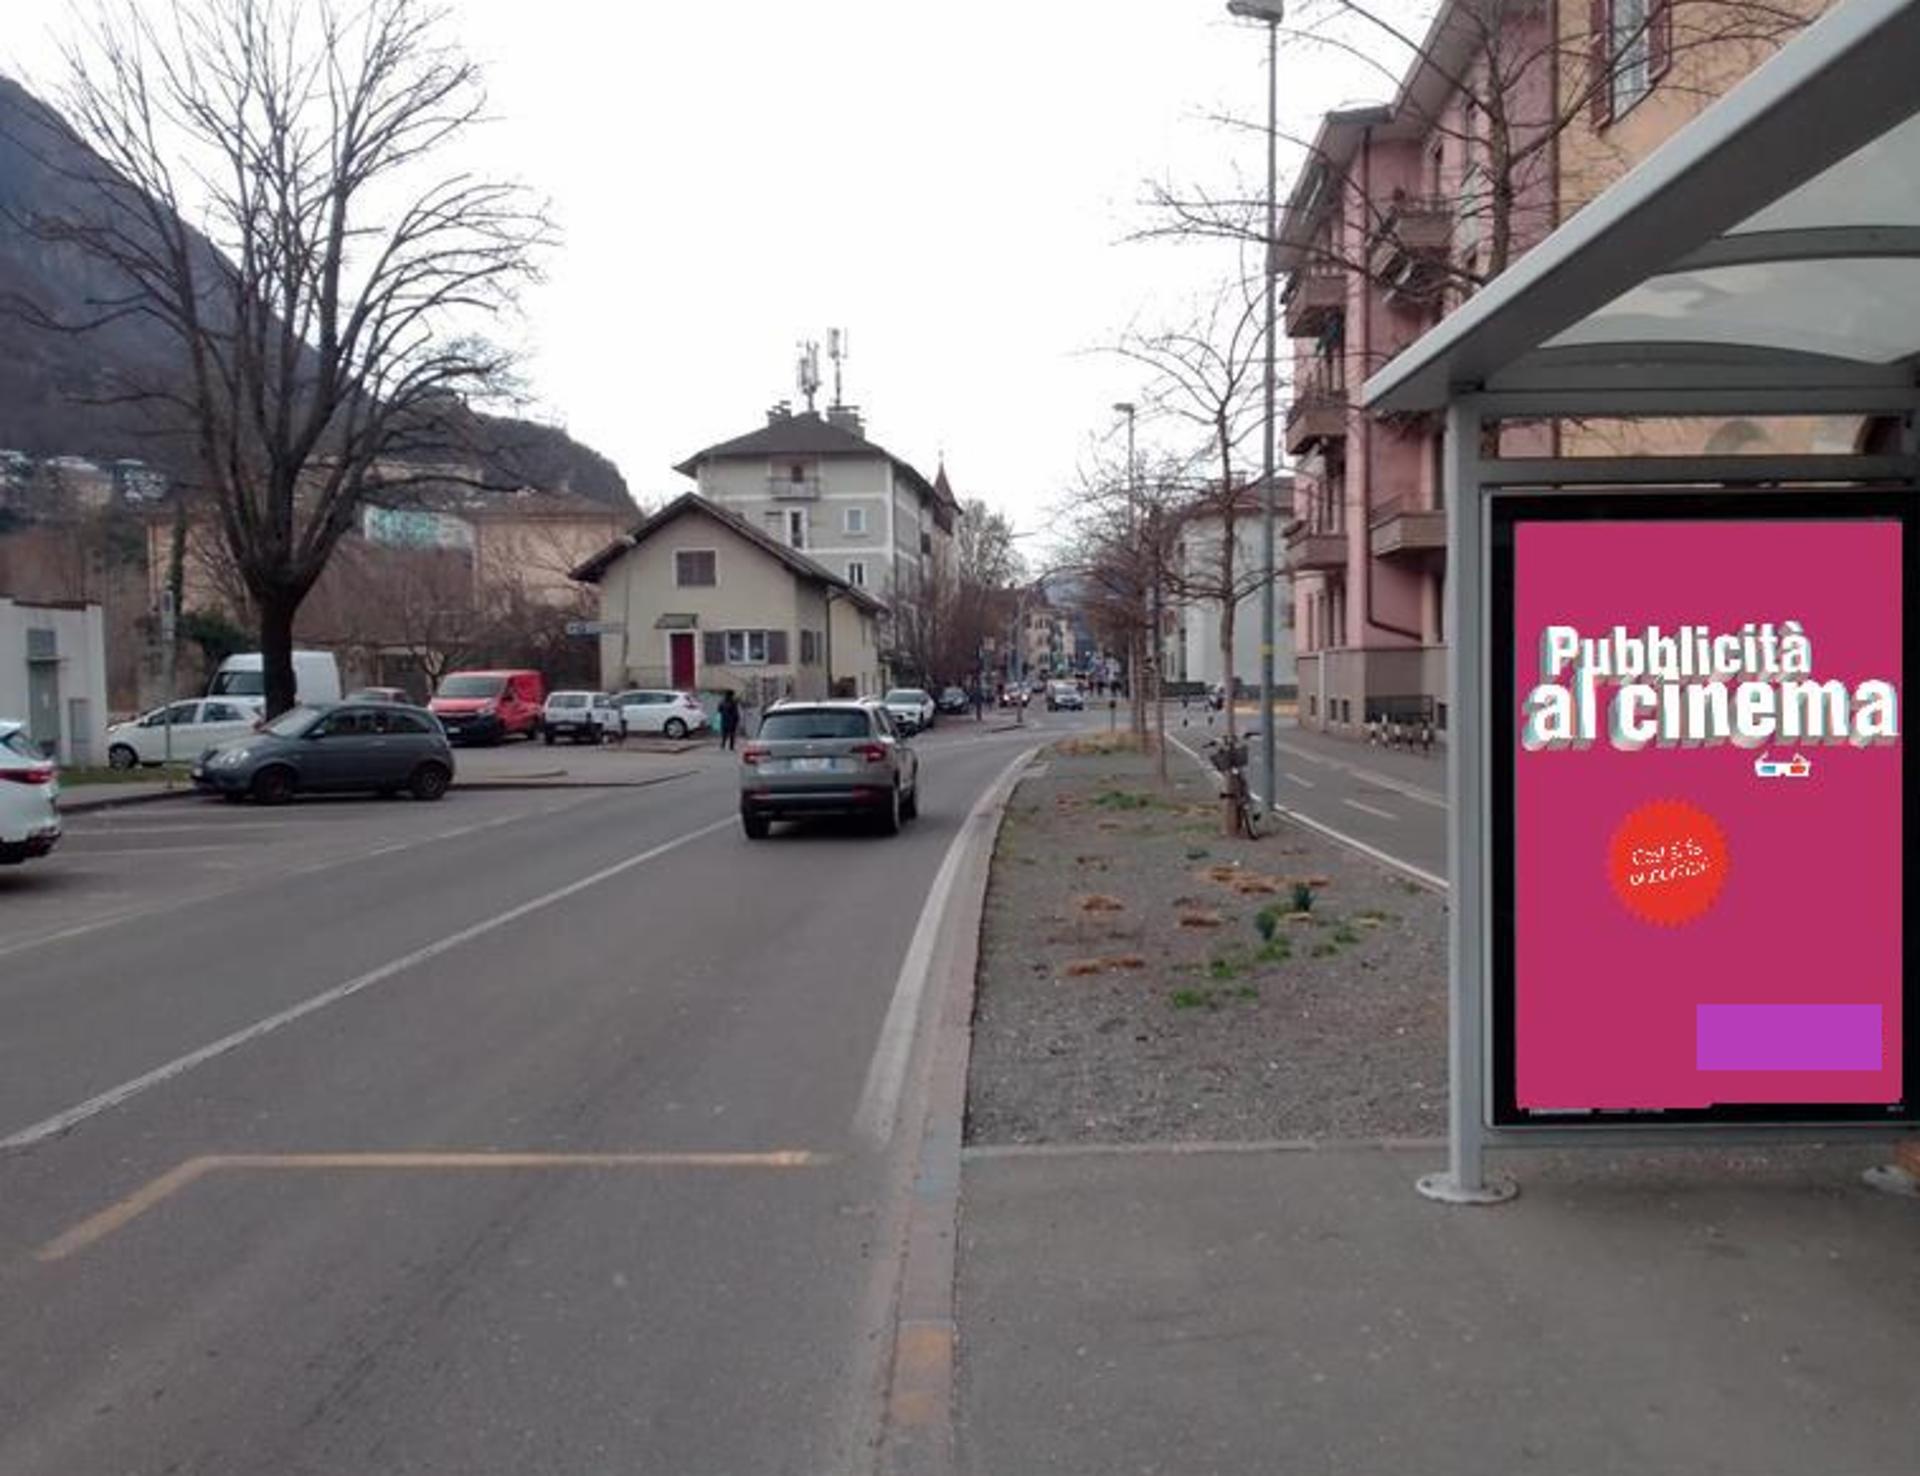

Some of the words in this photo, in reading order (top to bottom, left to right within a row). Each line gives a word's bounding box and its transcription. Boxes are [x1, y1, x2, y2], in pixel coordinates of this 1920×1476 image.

[1544, 620, 1812, 678] Pubblicità
[1523, 664, 1597, 750] al
[1610, 676, 1899, 749] cinema
